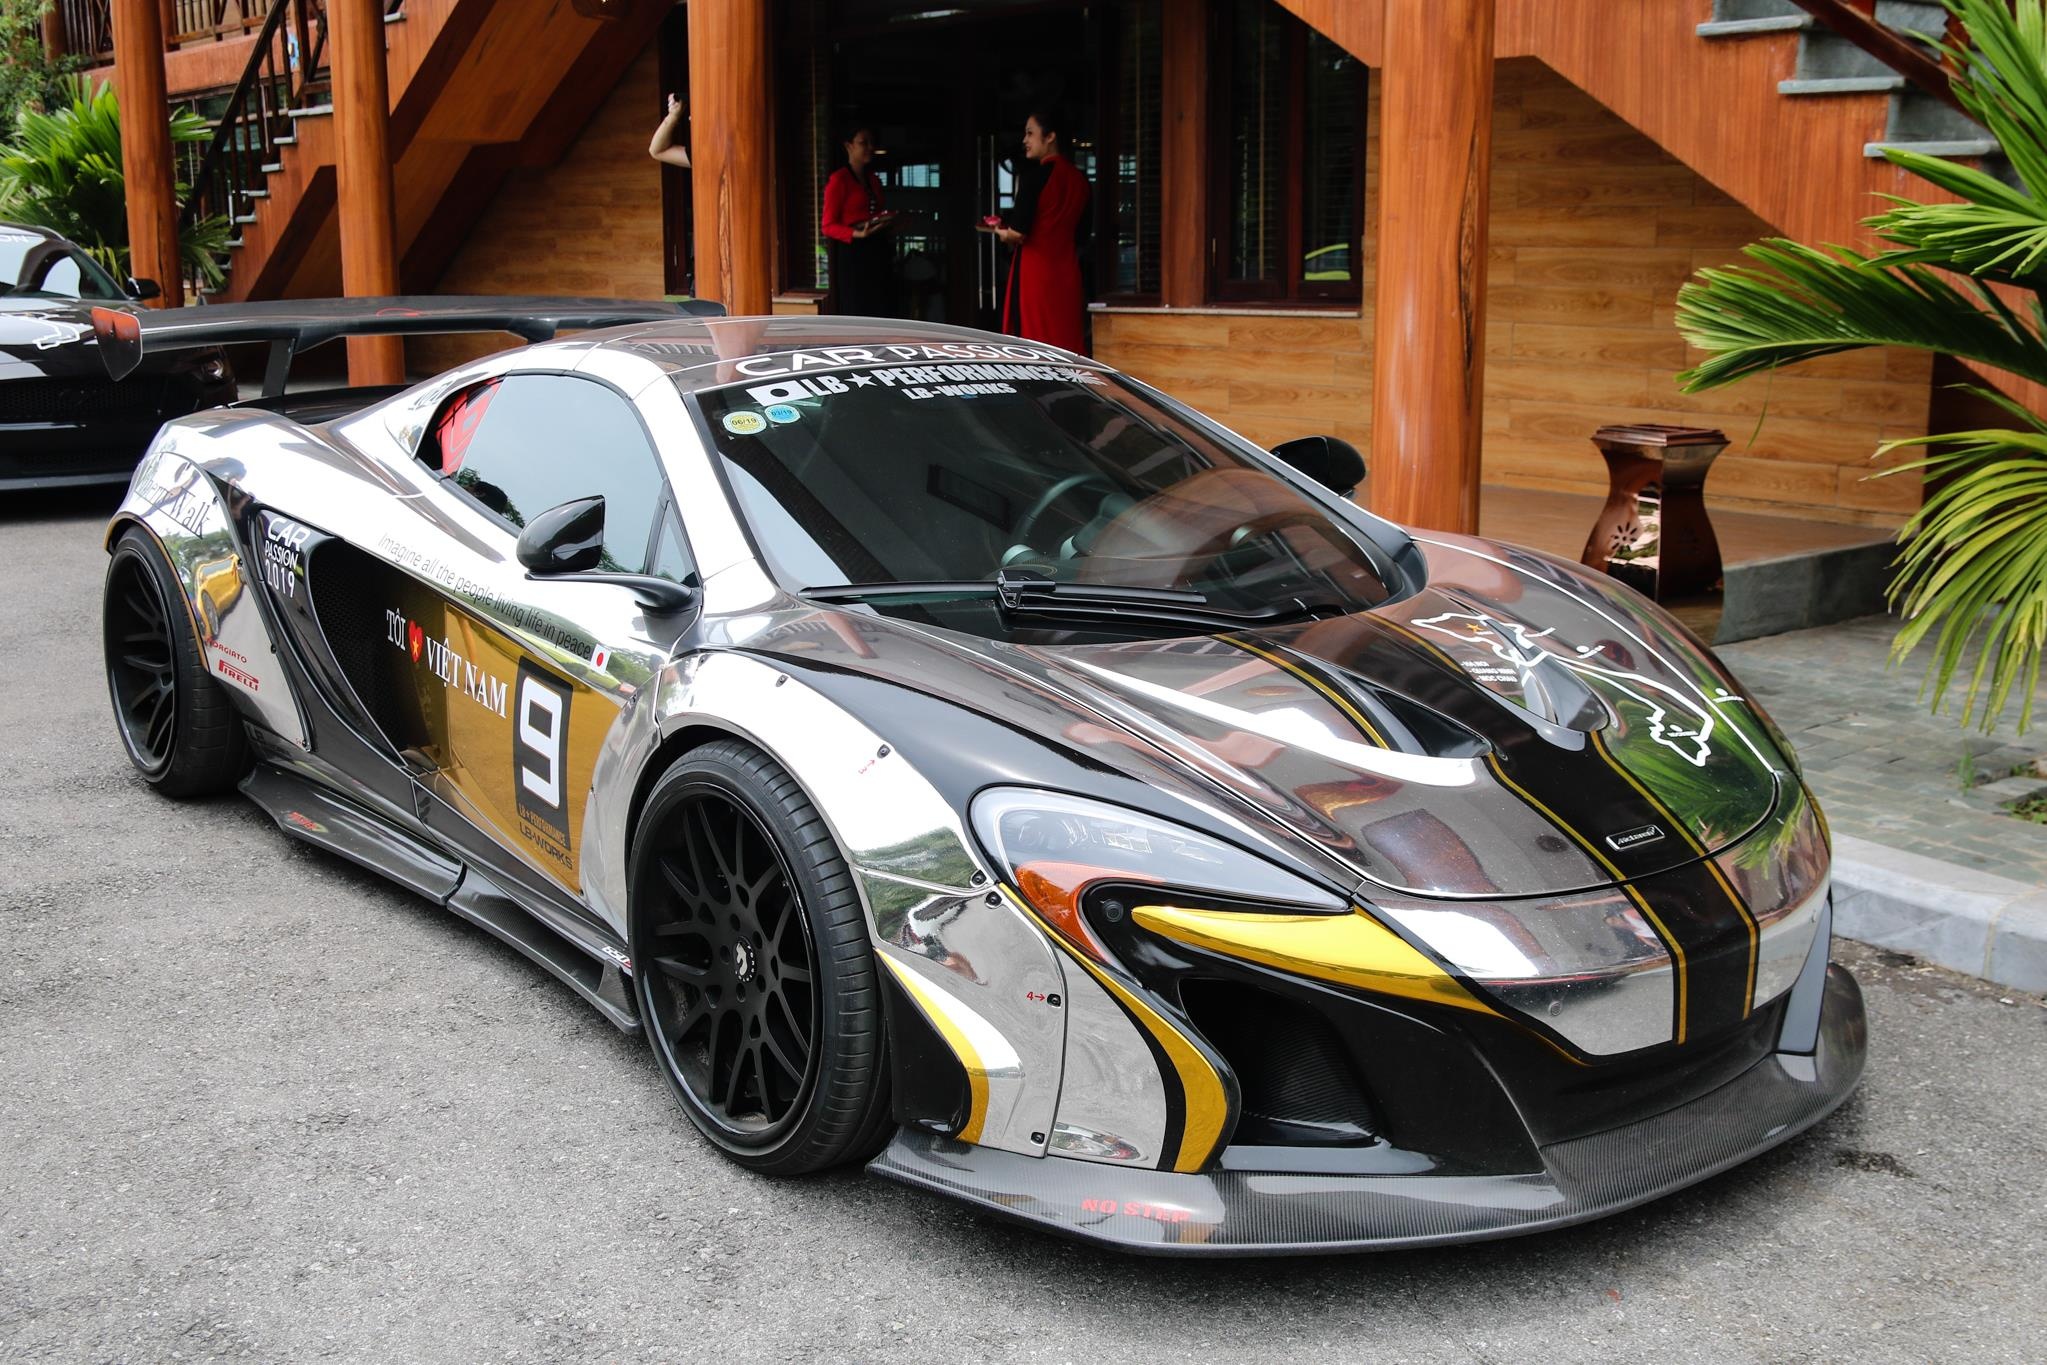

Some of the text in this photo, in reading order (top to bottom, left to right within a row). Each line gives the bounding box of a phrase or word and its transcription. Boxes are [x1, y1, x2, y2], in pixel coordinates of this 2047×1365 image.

[735, 344, 1075, 376] CAR PASSION
[800, 364, 1065, 397] LB PERFORMANCE
[901, 382, 1018, 401] LB-WORKS
[731, 417, 758, 427] 06/19
[268, 517, 311, 553] CAR
[265, 539, 299, 570] PASSION
[265, 558, 297, 599] 2019
[377, 532, 591, 660] Imagine all the people living life in peace
[218, 659, 259, 692] PIRELLI
[385, 607, 509, 719] TÔI VIỆT NAM
[520, 676, 563, 810] 9
[1080, 1199, 1192, 1224] NO STEP
